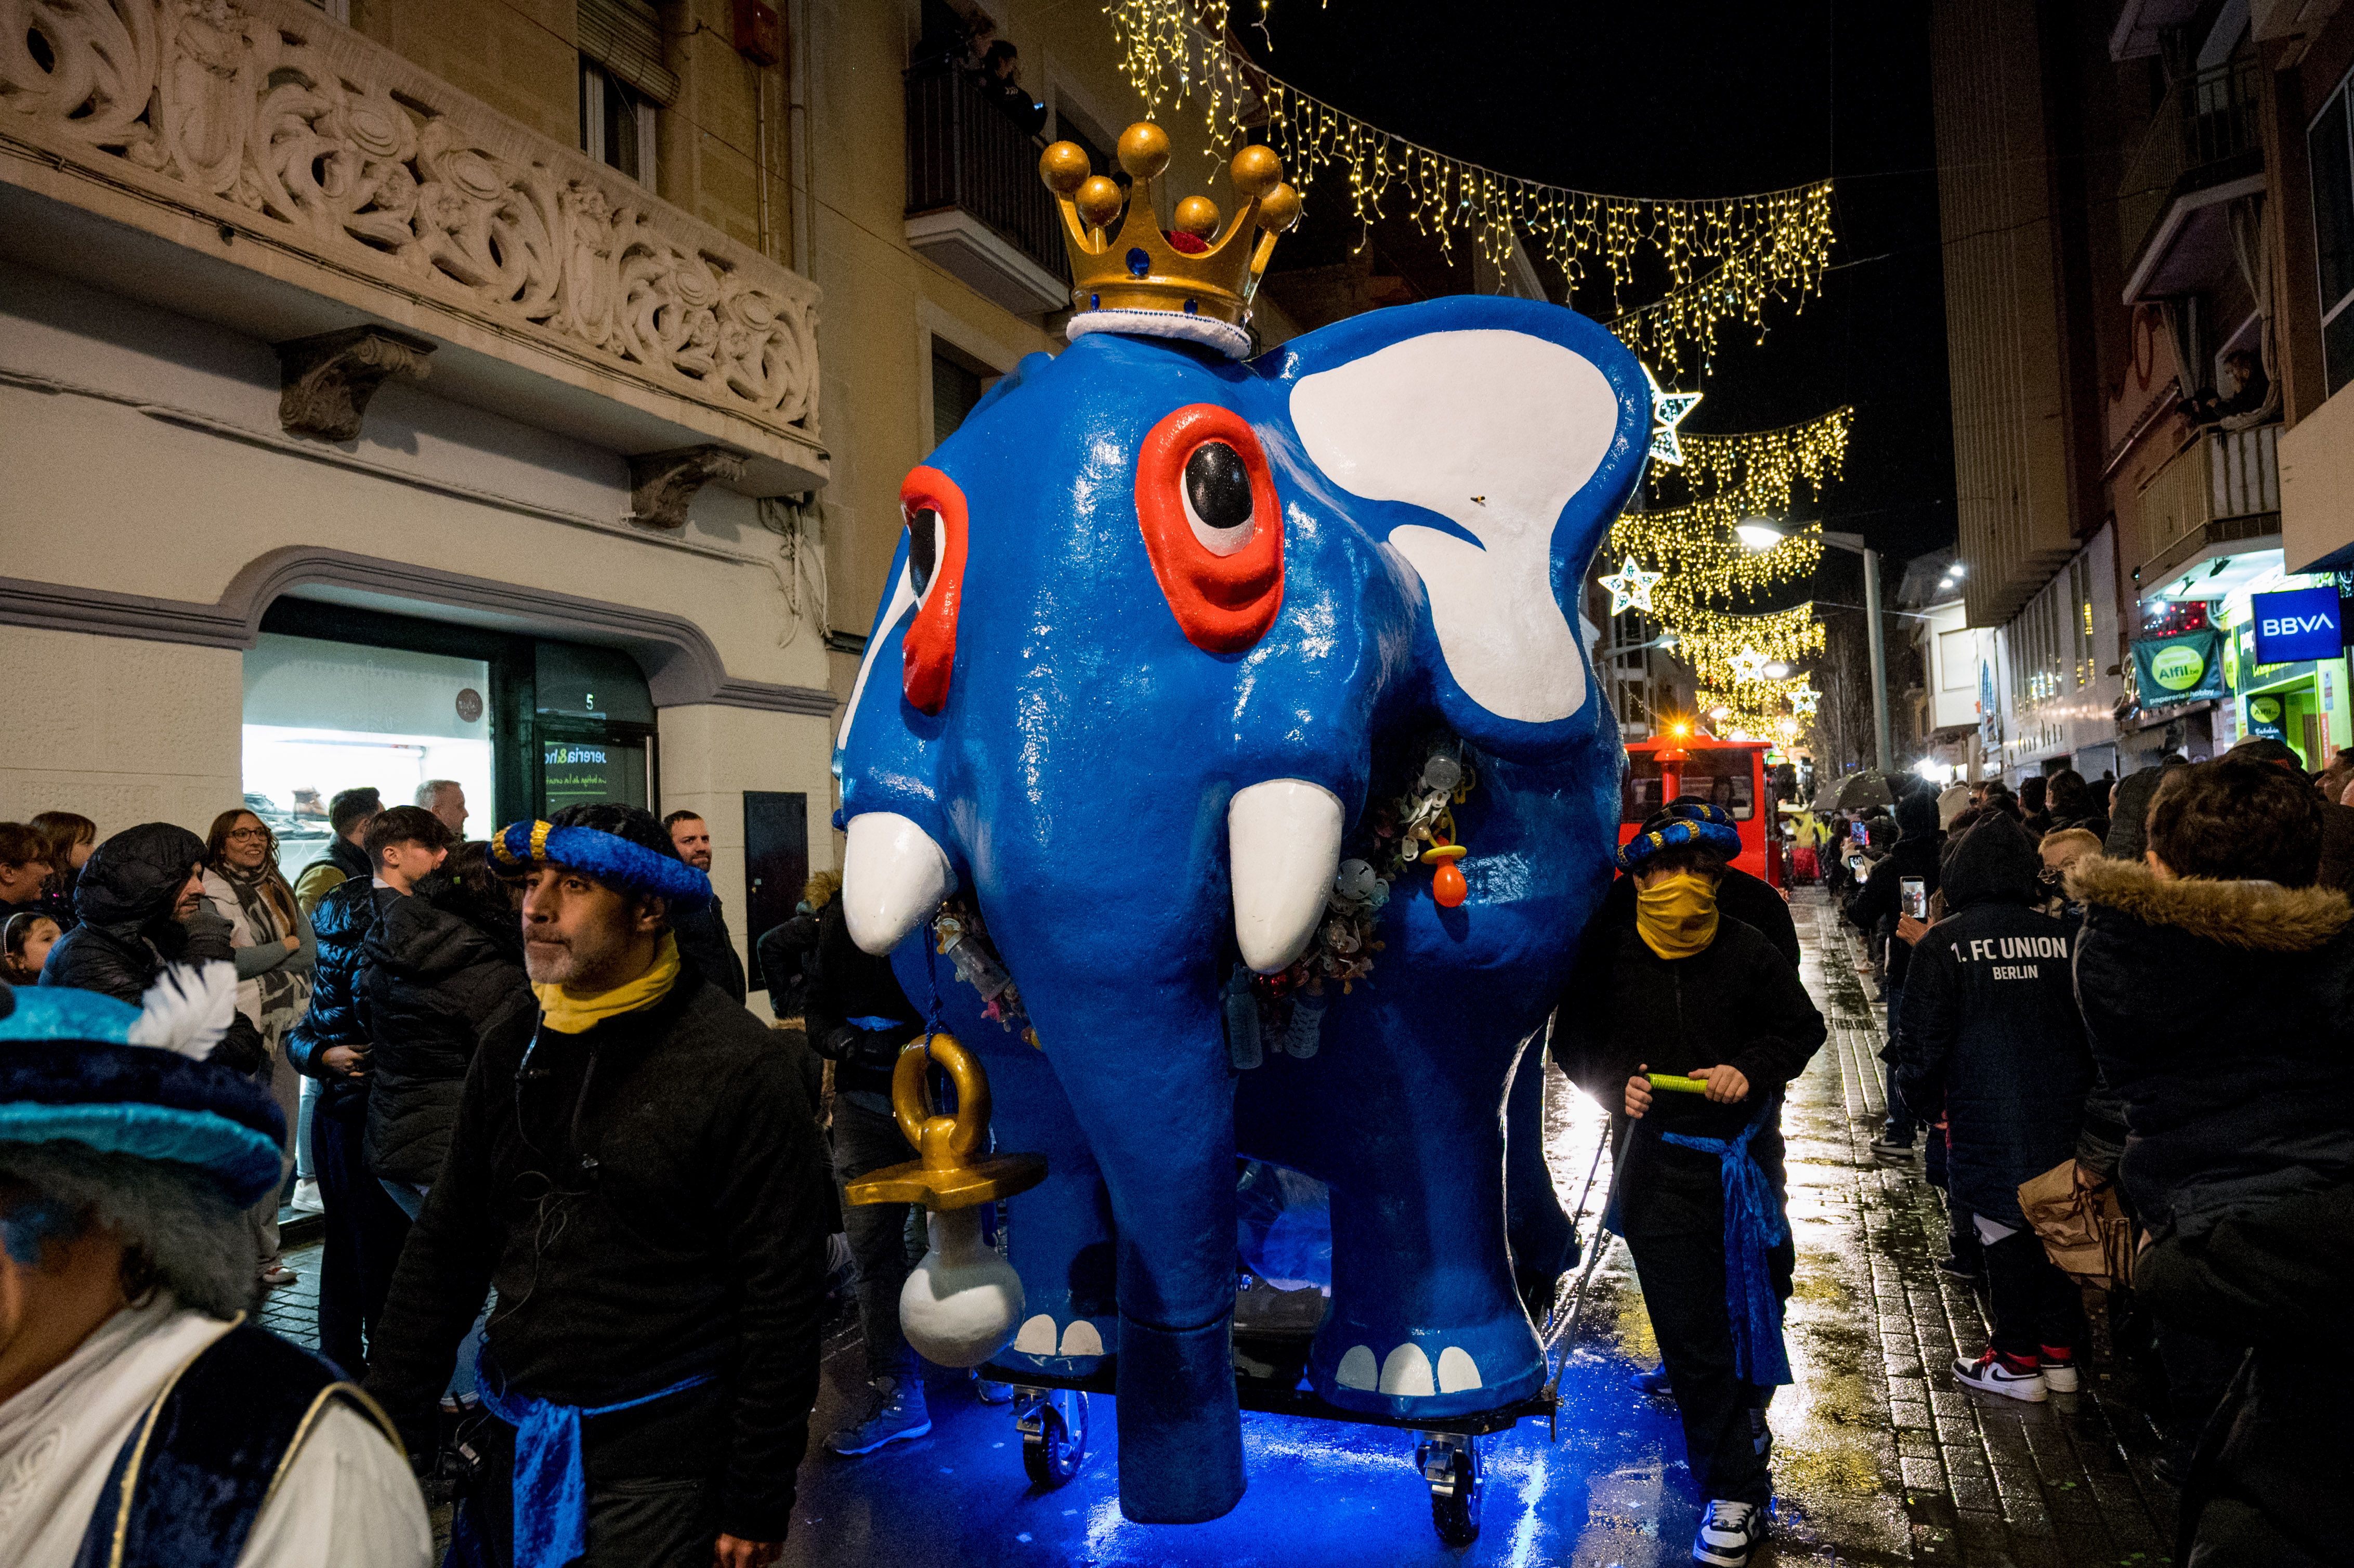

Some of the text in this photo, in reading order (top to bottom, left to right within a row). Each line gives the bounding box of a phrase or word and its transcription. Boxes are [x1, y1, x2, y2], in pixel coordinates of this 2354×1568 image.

[2263, 613, 2334, 637] BBVA
[586, 694, 594, 711] 5
[1950, 936, 2068, 963] 1. FC UNION
[1992, 965, 2038, 980] BERLIN
